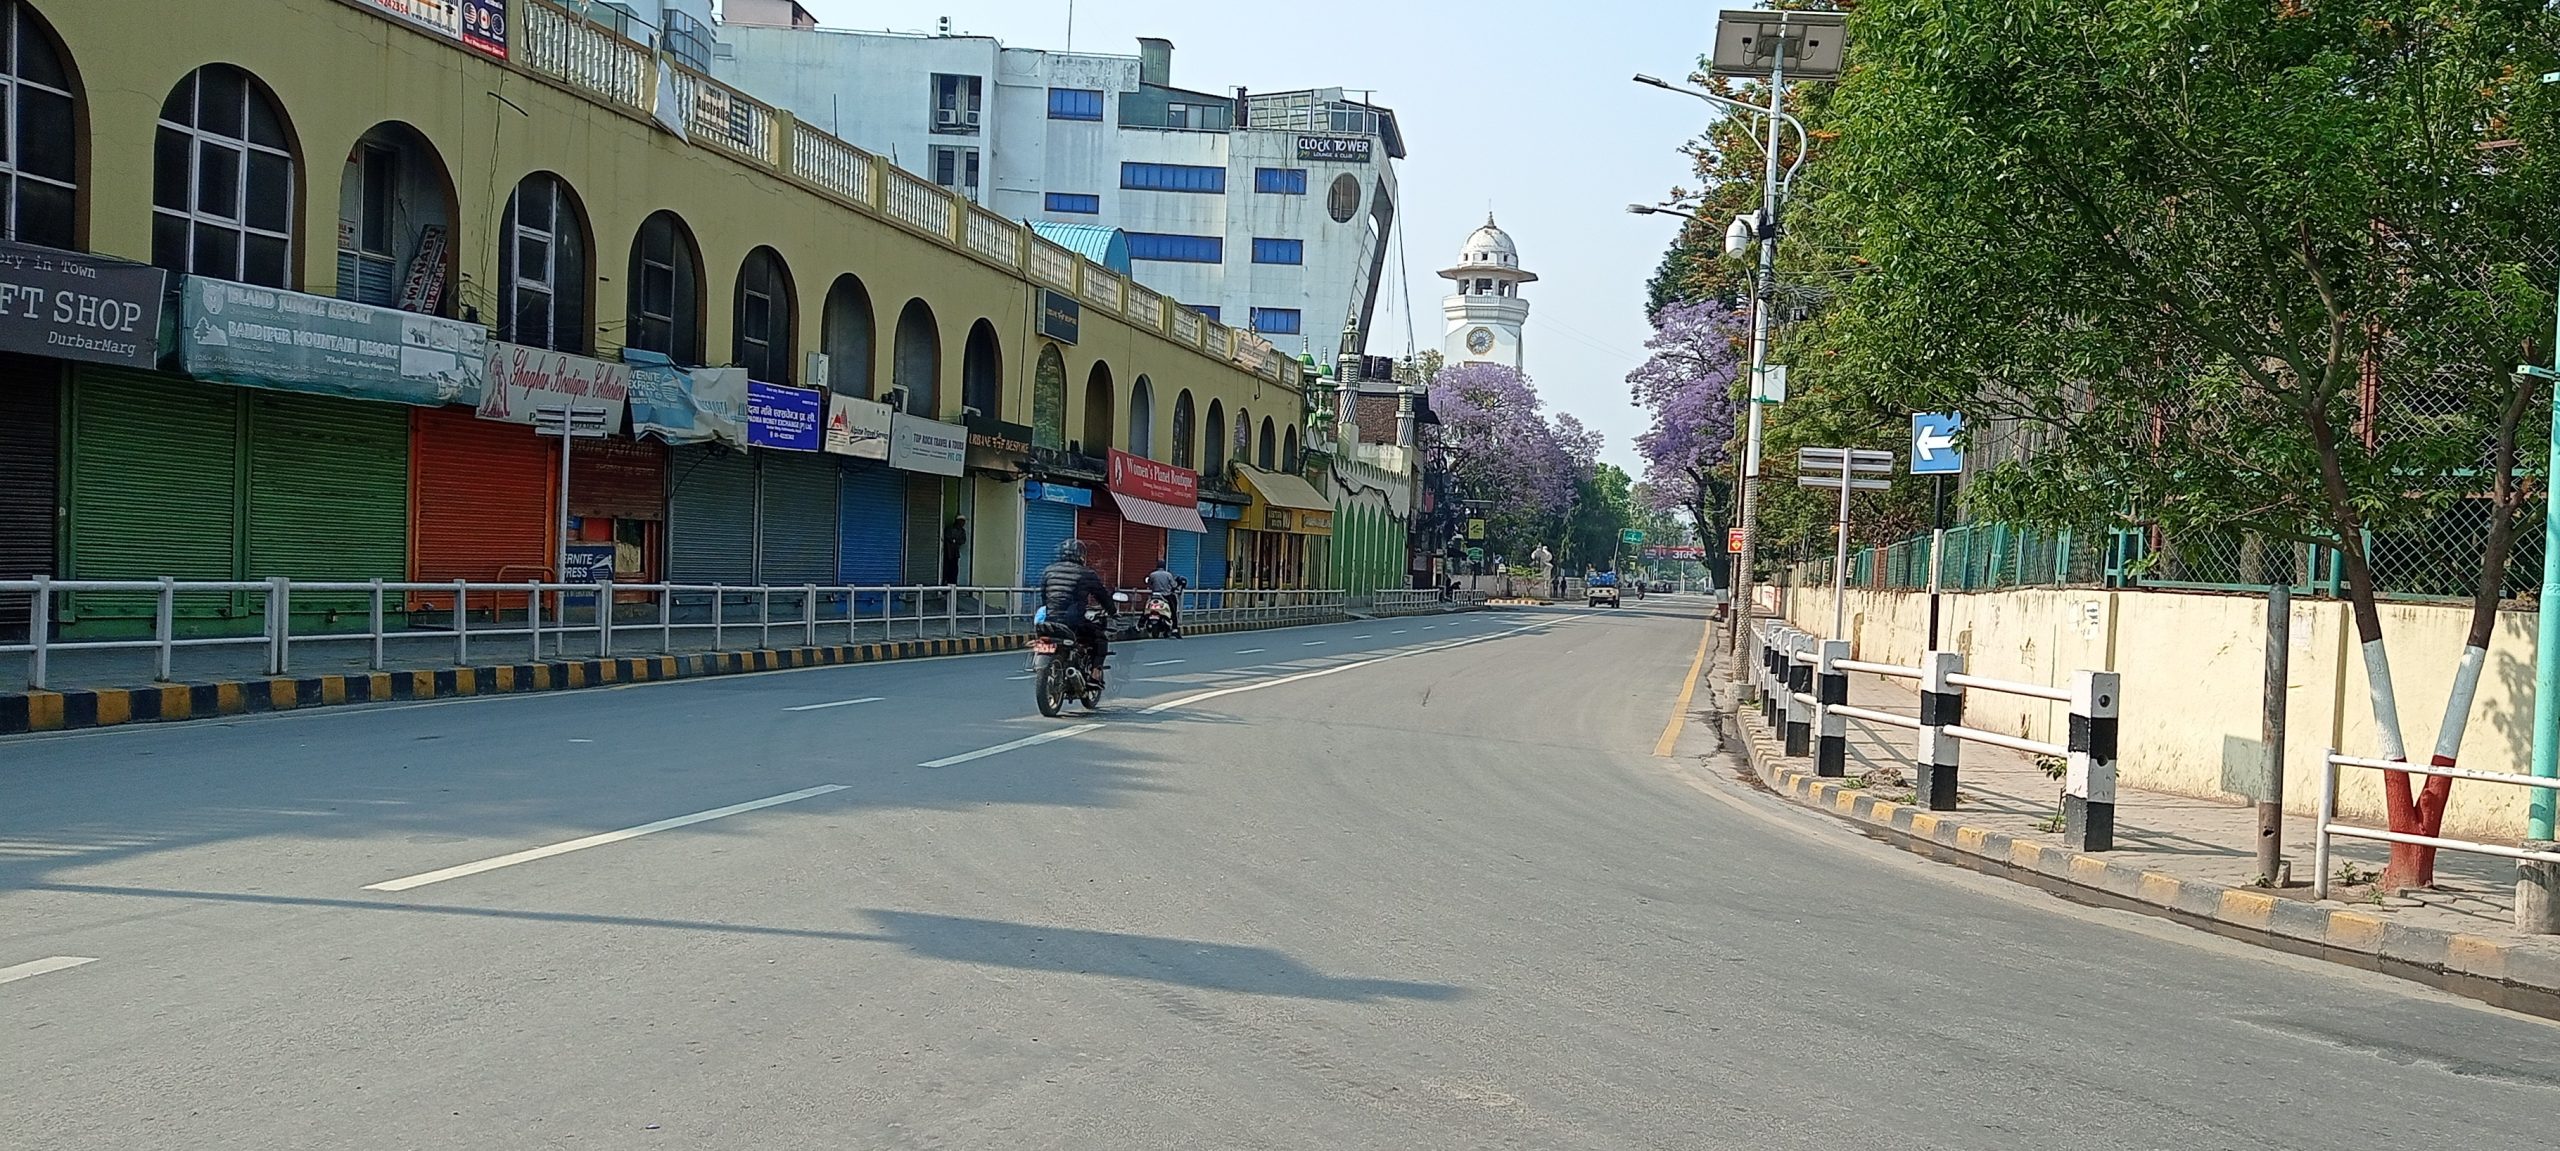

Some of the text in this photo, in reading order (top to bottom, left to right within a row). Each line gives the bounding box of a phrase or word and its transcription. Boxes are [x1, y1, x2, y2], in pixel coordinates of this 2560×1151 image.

[697, 96, 729, 122] Australia
[1298, 138, 1368, 153] CLOCK TOWER
[34, 255, 53, 271] in
[61, 260, 97, 279] Town
[0, 282, 141, 332] FT SHOP
[227, 286, 275, 310] ISLAND
[278, 294, 326, 317] JUNGLE
[328, 301, 376, 325] RESORT
[48, 331, 137, 358] DurbarMarg
[228, 321, 293, 345] BANDIPUR
[293, 329, 358, 354] MOUNTAIN
[359, 340, 400, 360] RESORT
[550, 356, 589, 406] Boutique
[592, 362, 625, 401] Collection
[913, 433, 921, 443] TOP
[1126, 457, 1153, 480] Women's
[1154, 465, 1170, 484] Planet
[1171, 469, 1193, 491] Boutique
